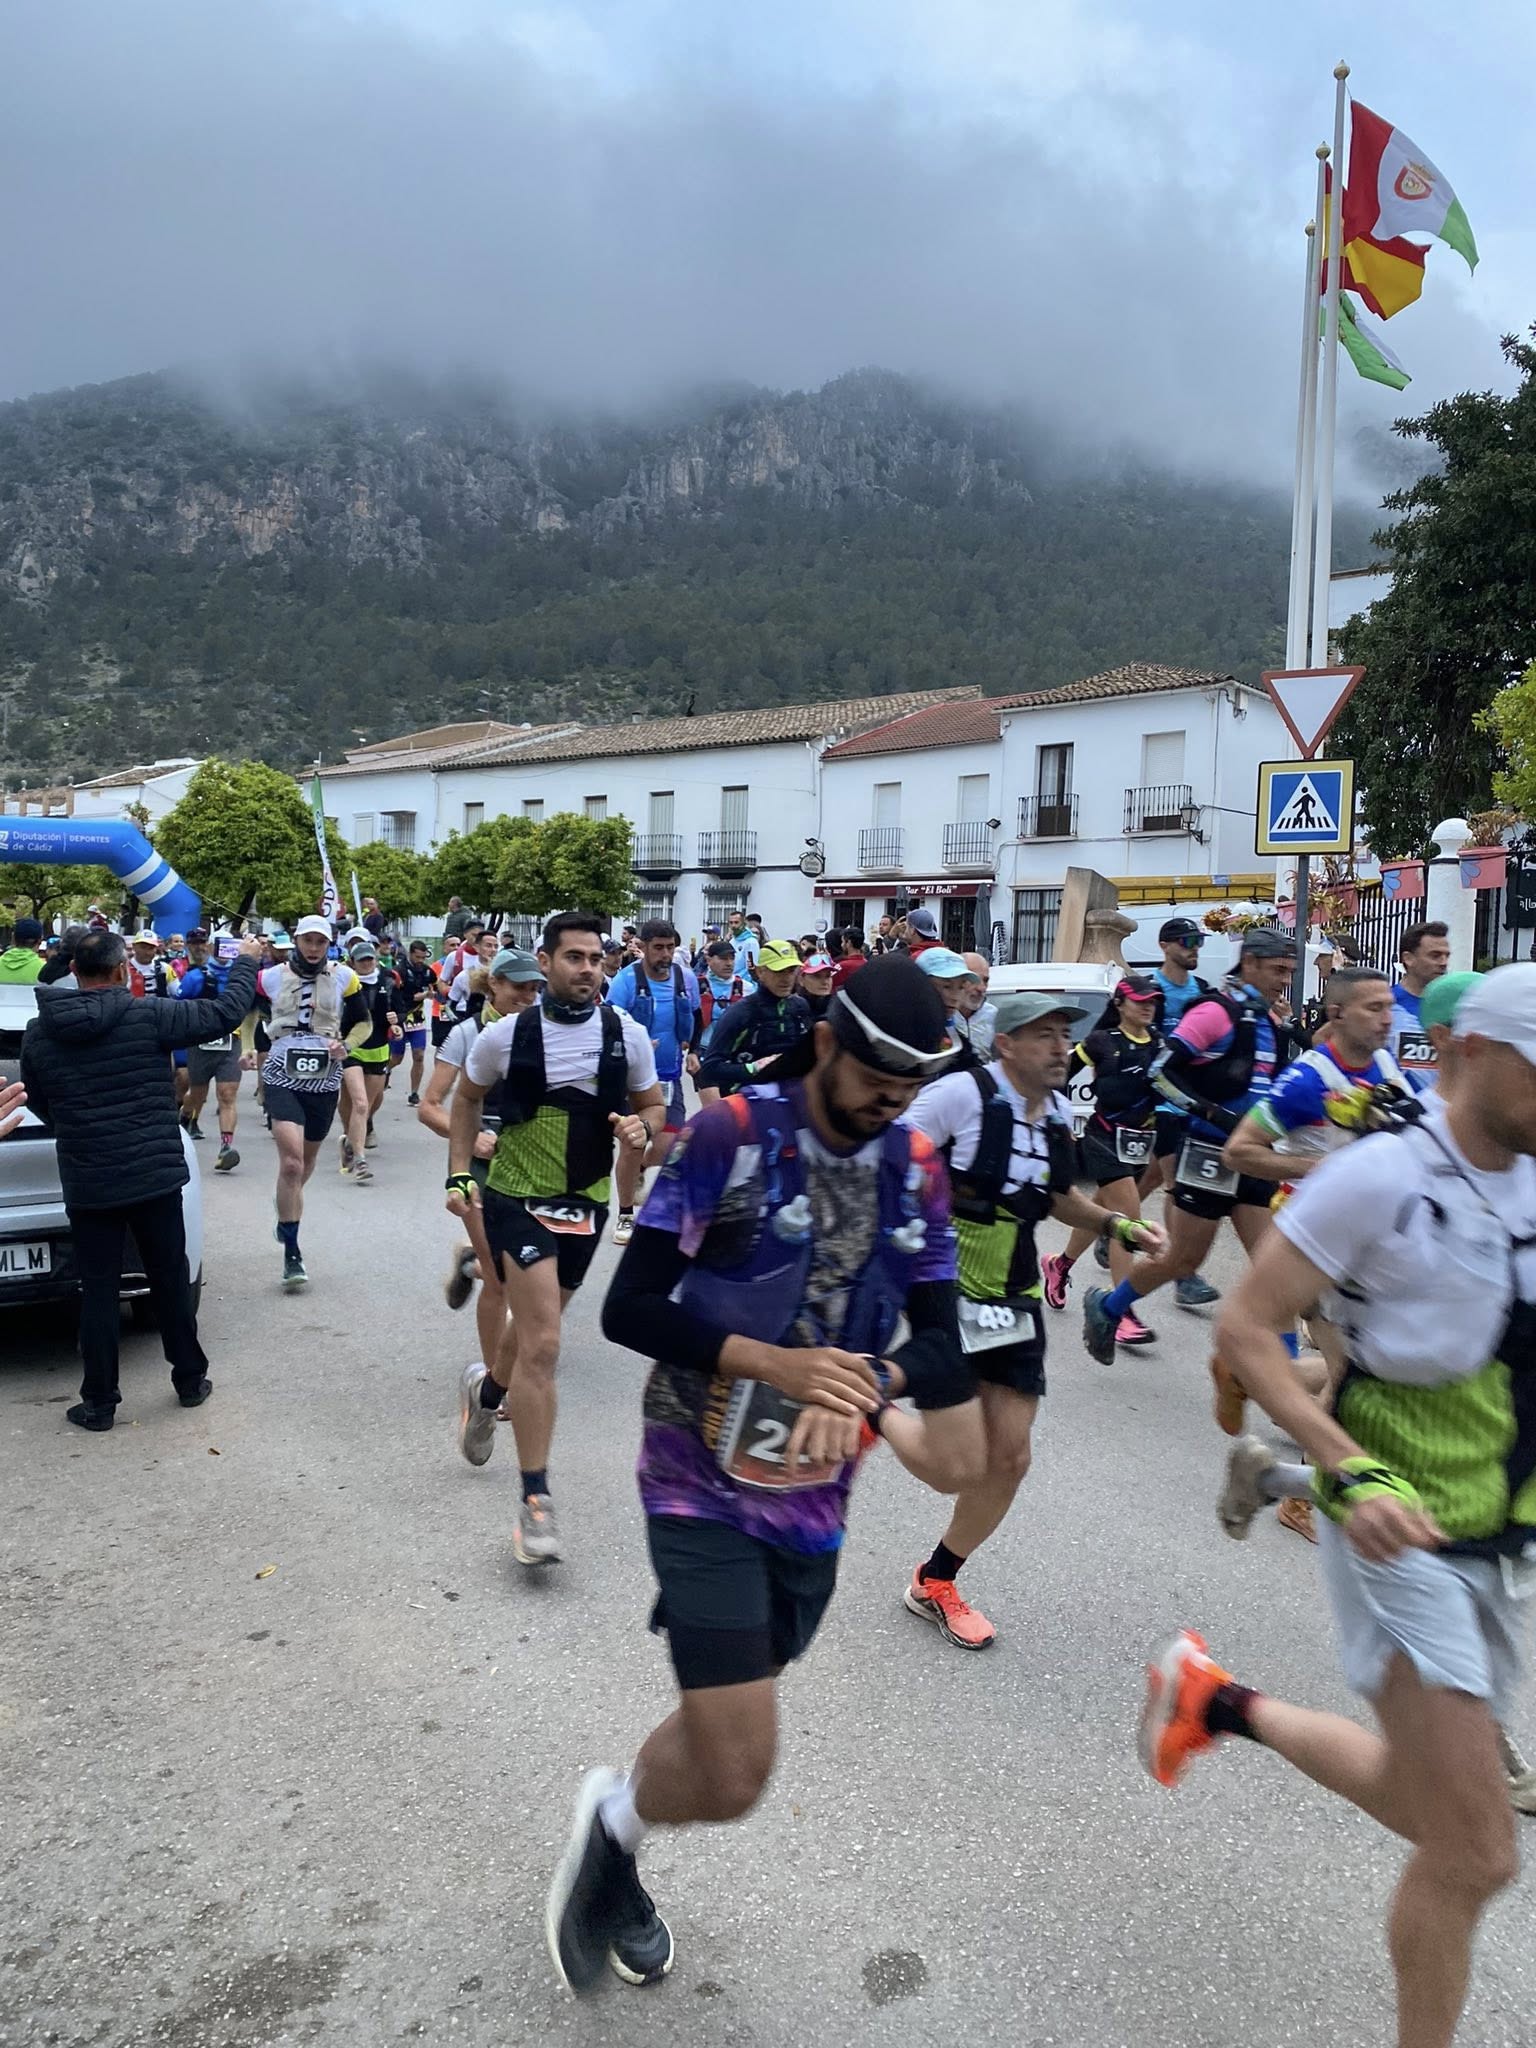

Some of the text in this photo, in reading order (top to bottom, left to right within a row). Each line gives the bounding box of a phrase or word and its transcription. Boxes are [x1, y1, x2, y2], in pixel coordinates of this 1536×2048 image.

[13, 831, 62, 841] Diputación
[69, 835, 110, 843] DEPORTES
[13, 843, 52, 851] de Cádiz
[905, 886, 919, 894] Bar
[296, 1057, 319, 1072] 68
[1200, 1159, 1219, 1178] 5
